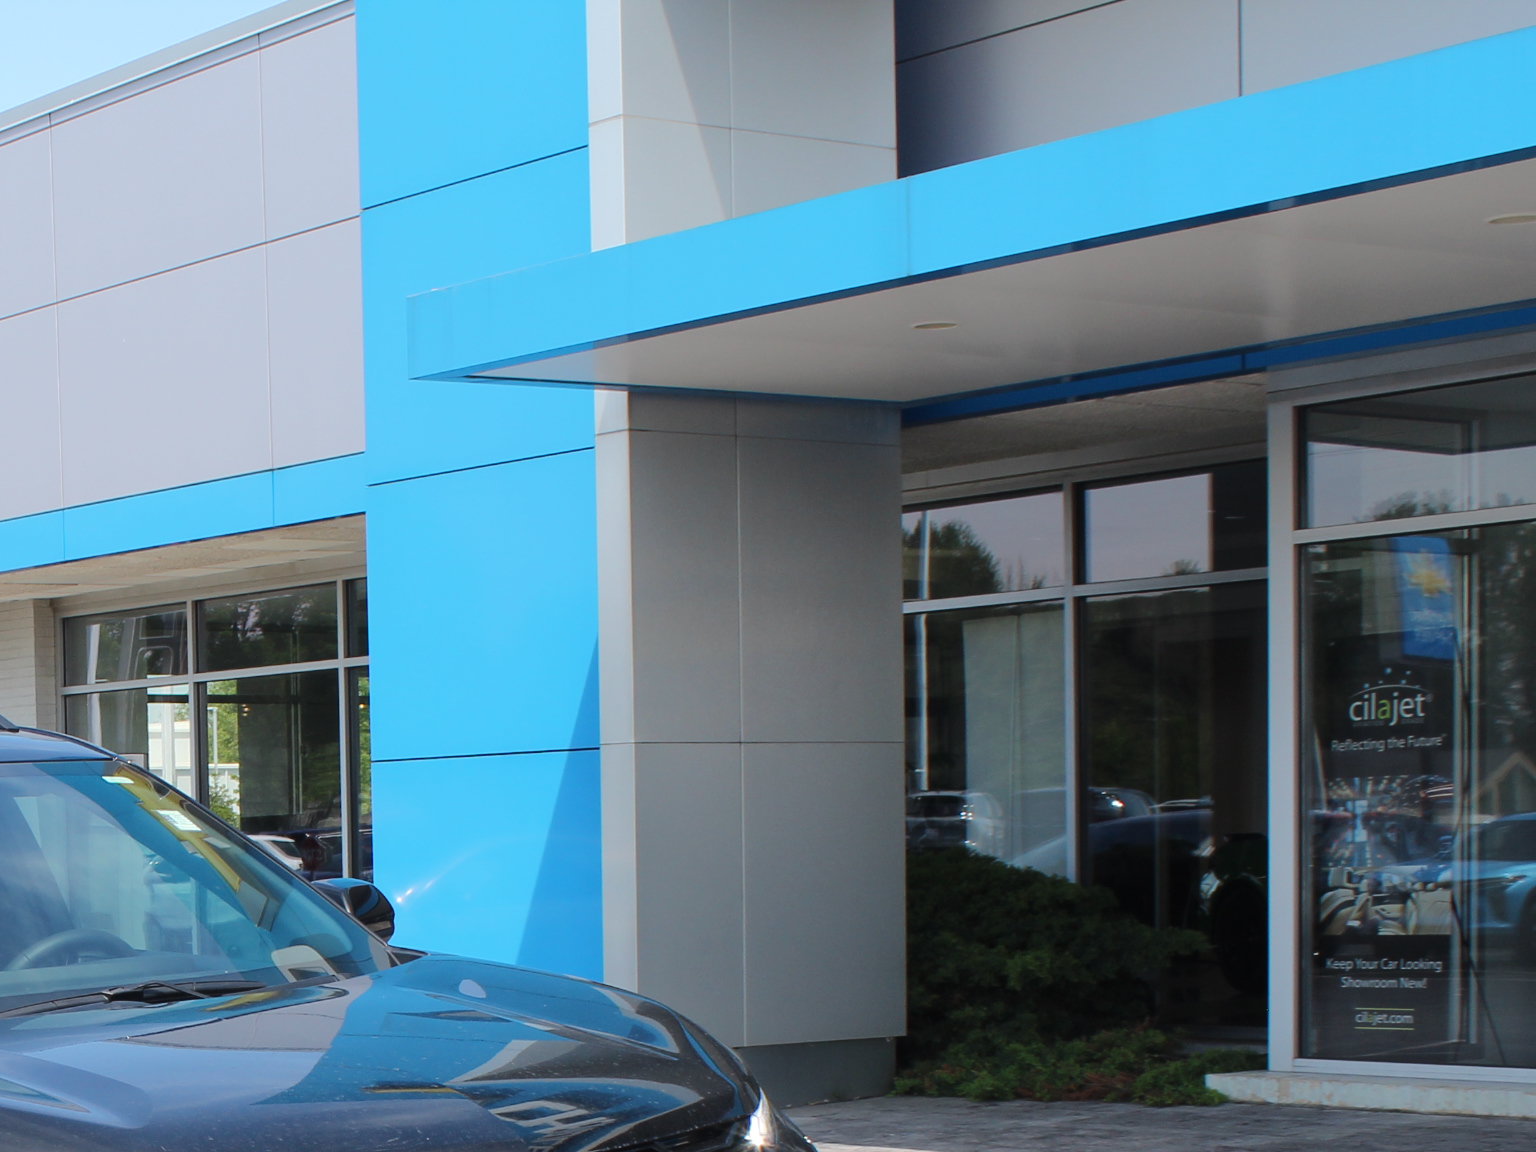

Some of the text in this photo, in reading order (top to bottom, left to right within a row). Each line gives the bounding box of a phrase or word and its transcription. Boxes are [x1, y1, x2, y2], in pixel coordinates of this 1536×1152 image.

[1349, 692, 1426, 726] cilajet
[1331, 739, 1385, 752] Reflecting
[1387, 737, 1406, 748] the
[1326, 958, 1443, 973] Keep Your Car Looking
[1341, 976, 1428, 989] Showroom New!
[1355, 1011, 1414, 1026] cilajet.com
